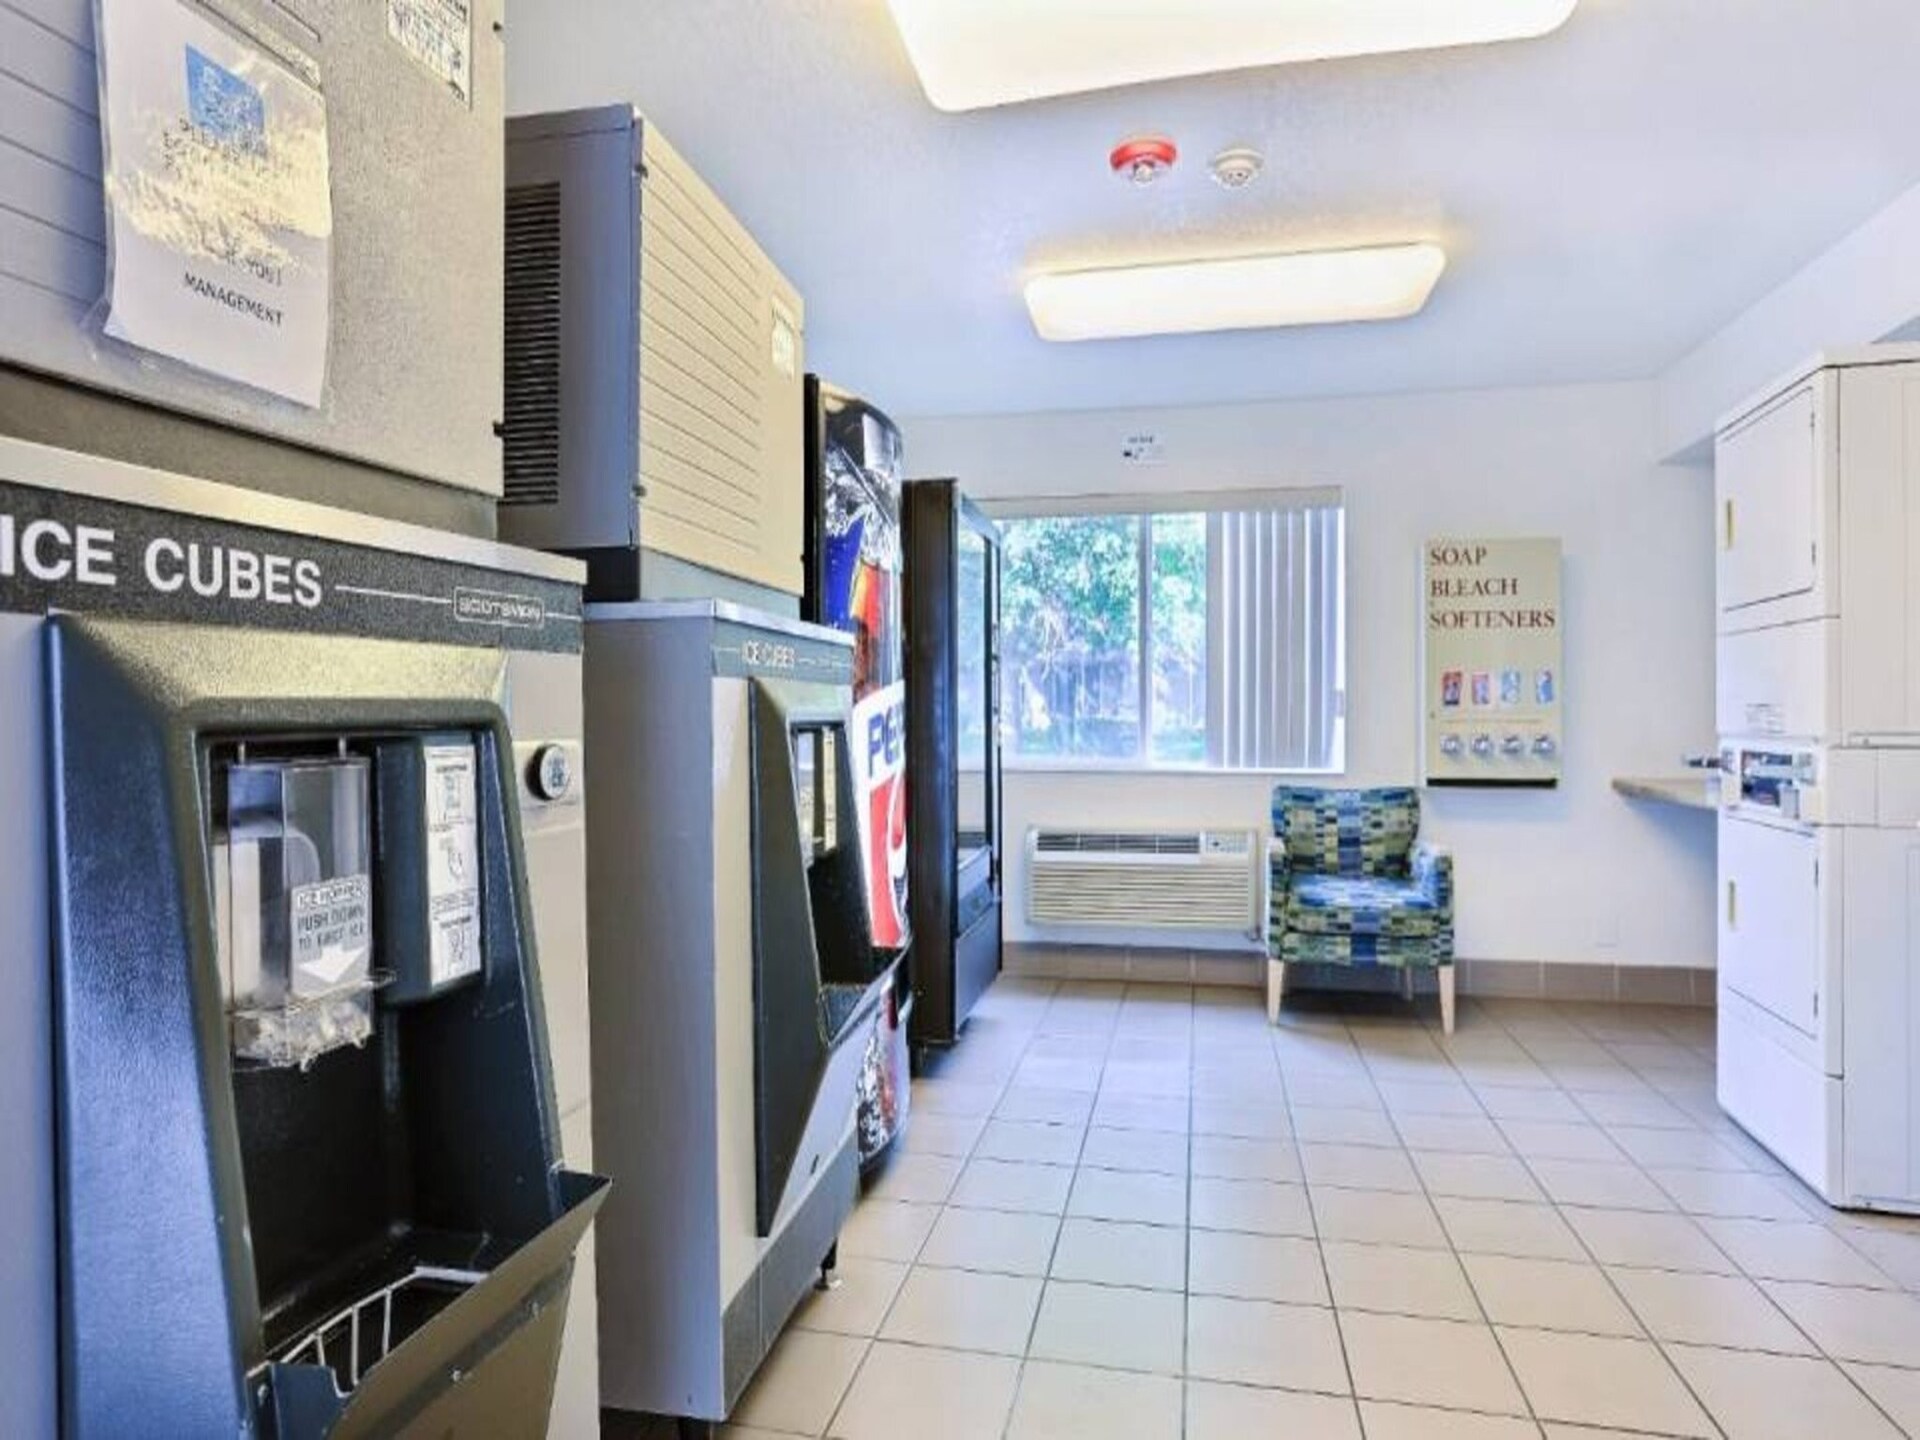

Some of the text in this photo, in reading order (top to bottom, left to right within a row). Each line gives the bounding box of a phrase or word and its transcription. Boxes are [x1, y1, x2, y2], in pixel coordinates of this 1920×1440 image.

[184, 271, 283, 326] MANAGEMENT
[0, 514, 322, 608] ICE CUBES
[1430, 546, 1487, 566] SOAP
[1431, 578, 1518, 597] BLEACH
[1430, 610, 1555, 628] SOFTENERS
[298, 911, 329, 933] PUSH
